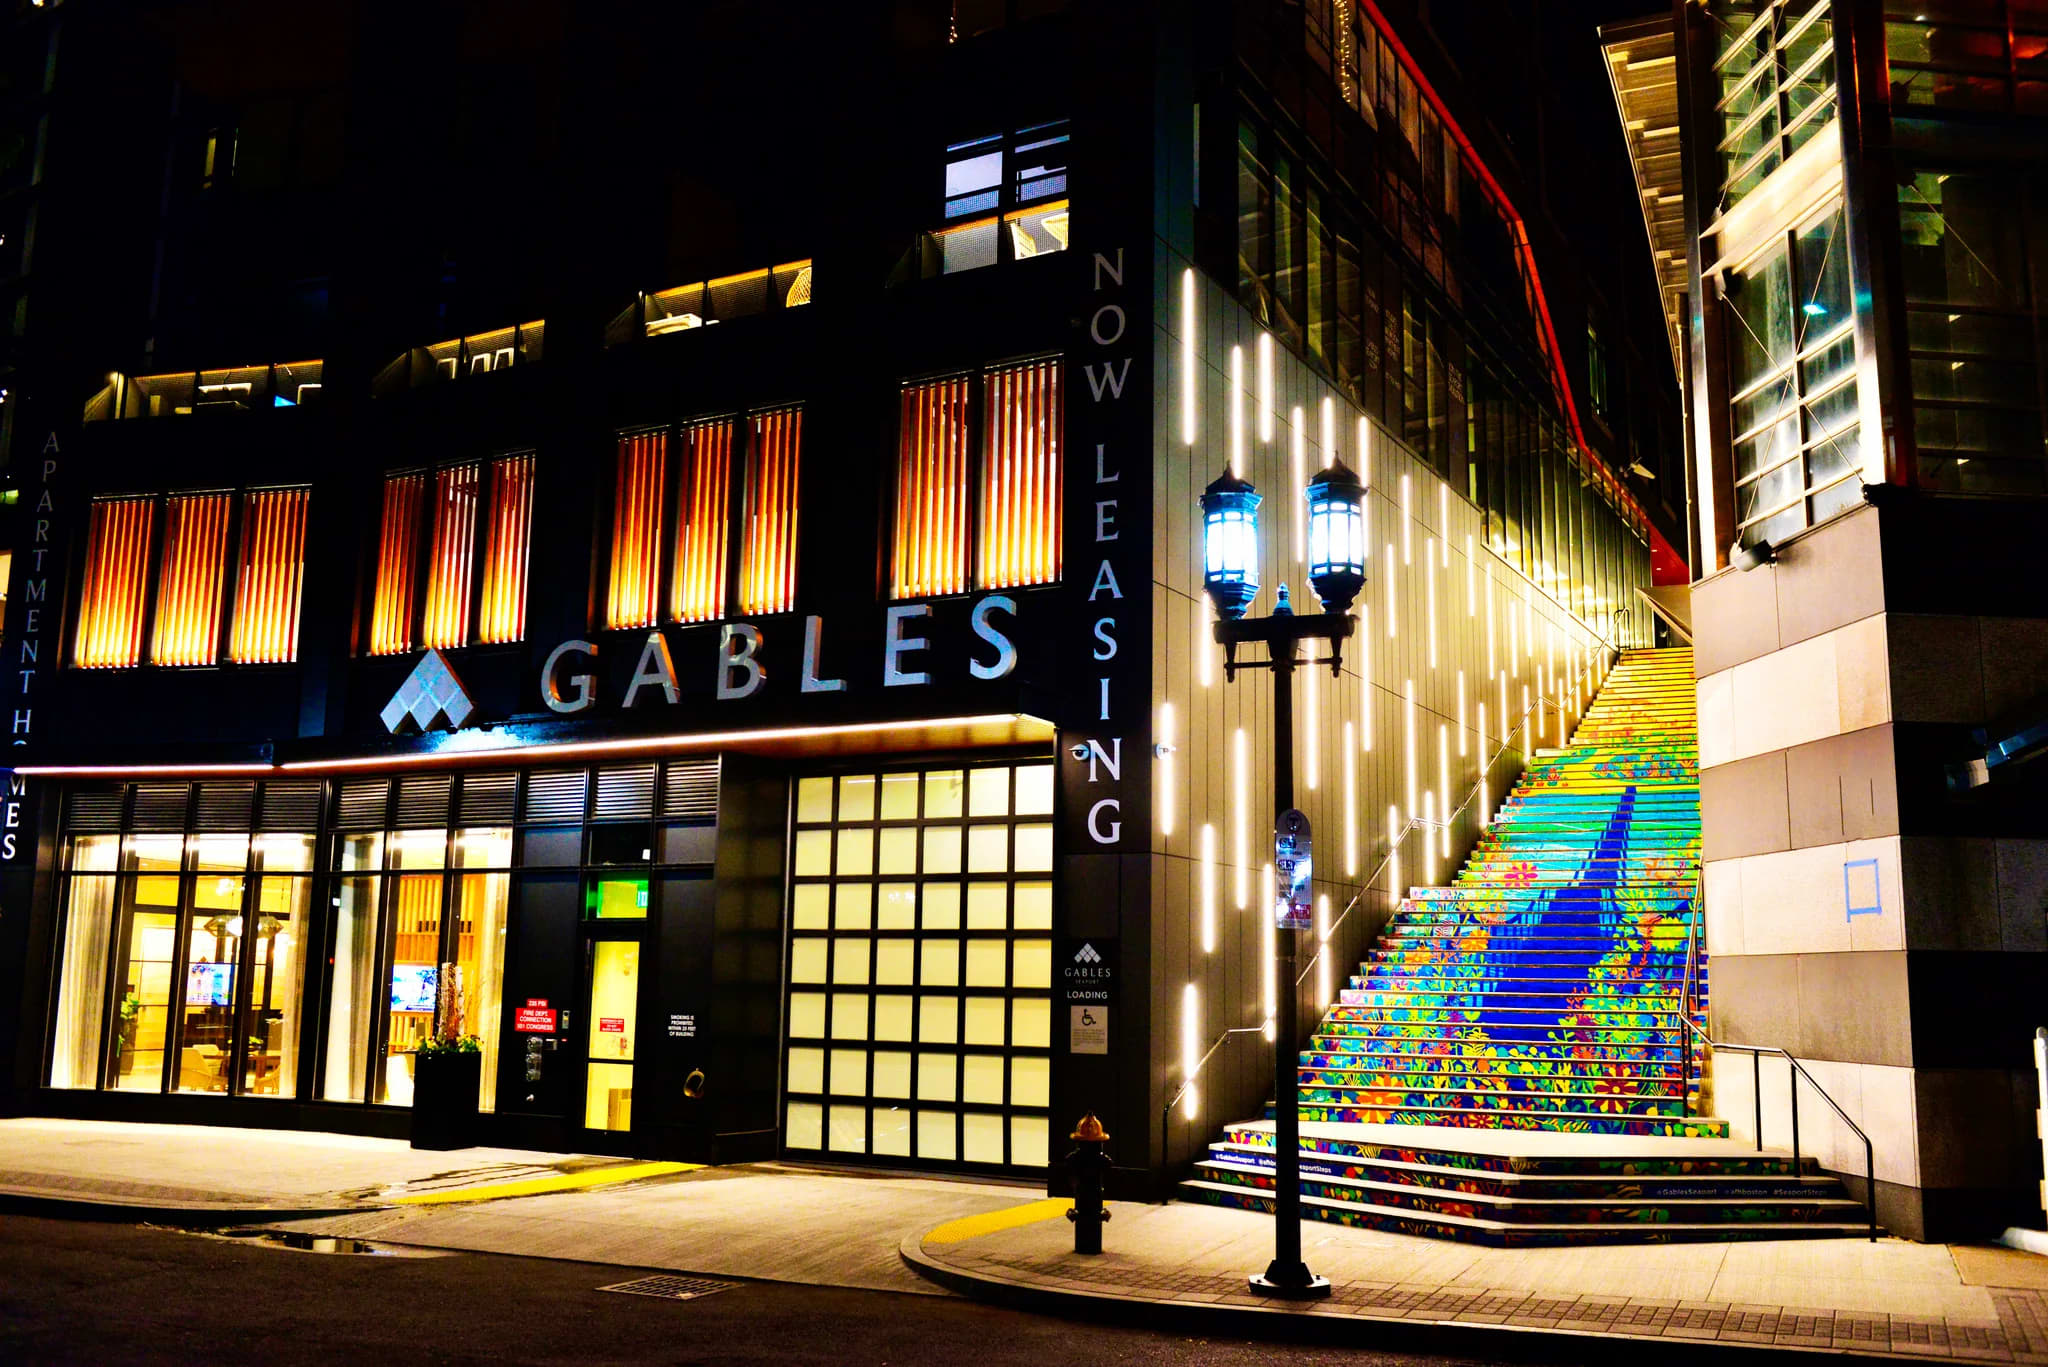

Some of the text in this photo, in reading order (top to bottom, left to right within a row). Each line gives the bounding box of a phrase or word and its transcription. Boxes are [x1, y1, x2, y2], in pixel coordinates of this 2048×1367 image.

[1084, 248, 1132, 844] NOW LEASING
[2, 431, 60, 859] APARTMENT HMES
[540, 596, 1017, 713] GABLES
[1064, 968, 1111, 977] GABLES
[1067, 991, 1108, 999] LOADING
[526, 1023, 553, 1031] CONGRESS
